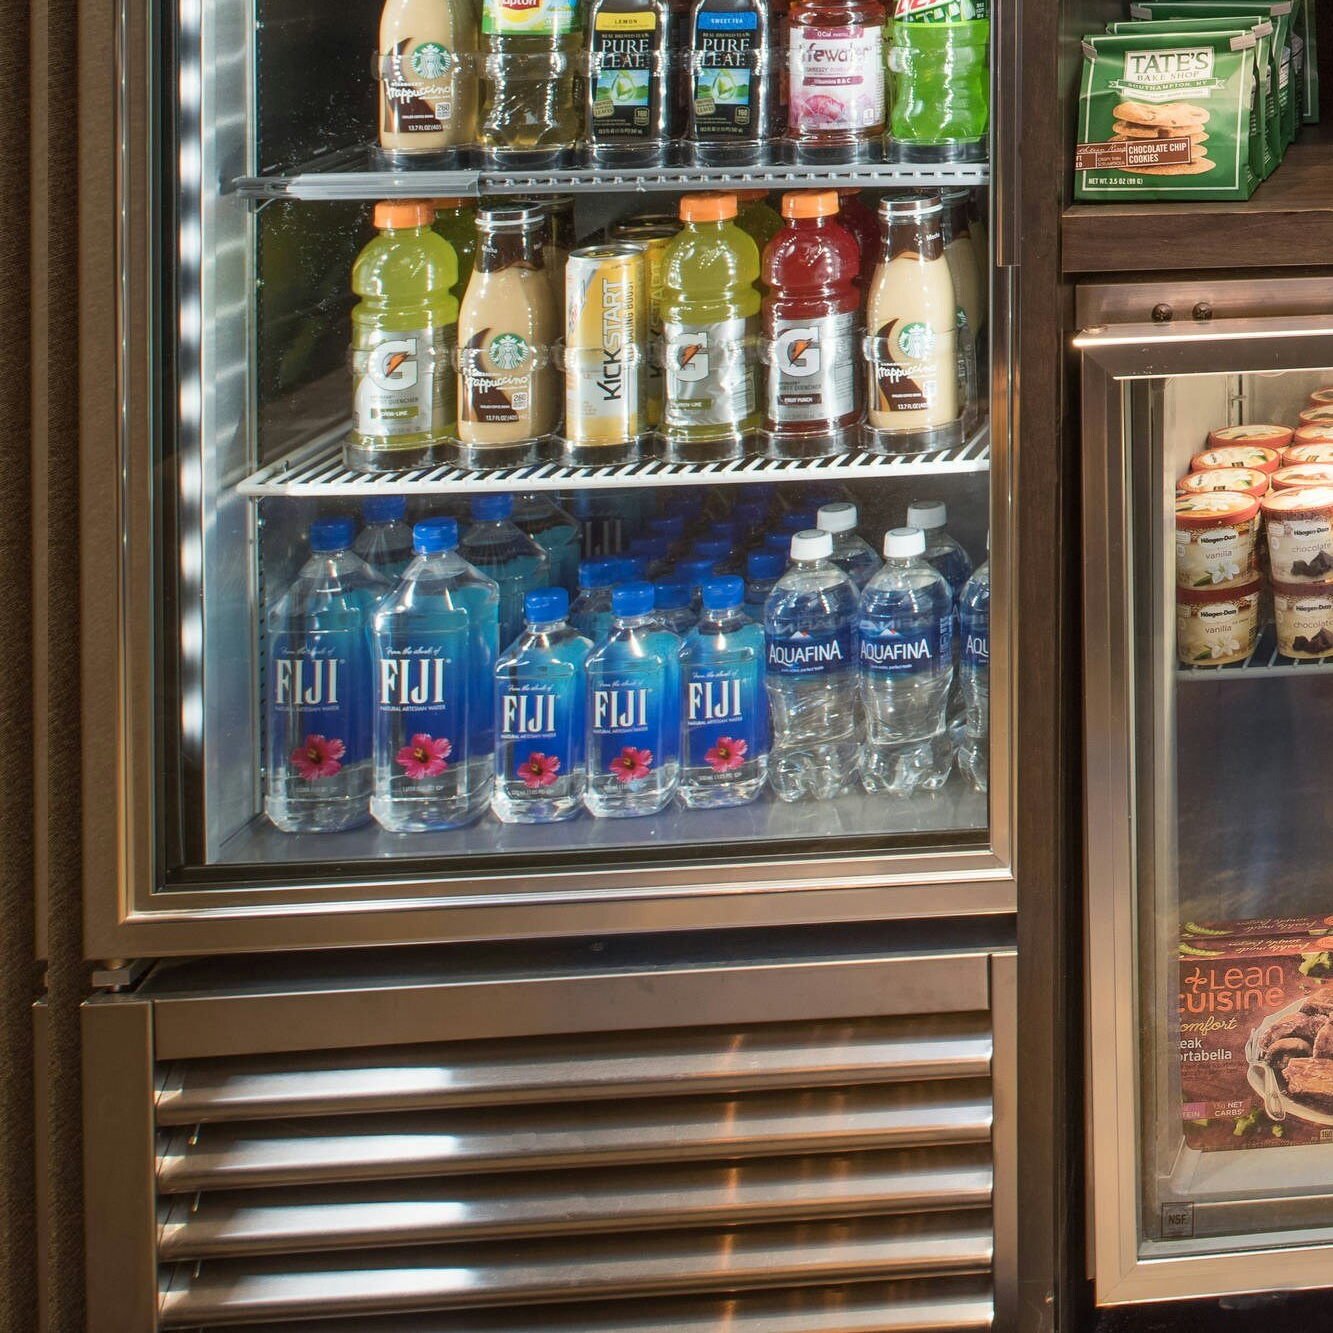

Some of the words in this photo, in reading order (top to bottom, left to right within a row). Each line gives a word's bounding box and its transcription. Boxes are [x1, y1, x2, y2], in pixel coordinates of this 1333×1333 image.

[601, 39, 649, 54] PURE
[702, 38, 750, 52] PURE
[1128, 144, 1168, 155] CHOCOLATE
[1169, 142, 1187, 153] CHIP
[1128, 153, 1159, 164] COOKIES
[1205, 550, 1233, 559] vanilla
[1292, 542, 1332, 554] chocolate
[1205, 625, 1232, 634] vanilla
[1293, 619, 1333, 629] chocolate
[768, 640, 842, 664] AQUAFINA
[860, 640, 932, 663] AQUAFINA
[276, 659, 339, 704] FIJI
[381, 658, 445, 704] FIJI
[594, 689, 648, 730] FIJI
[688, 679, 743, 721] FIJI
[503, 694, 556, 733] FIJI
[1210, 965, 1284, 990] Lean
